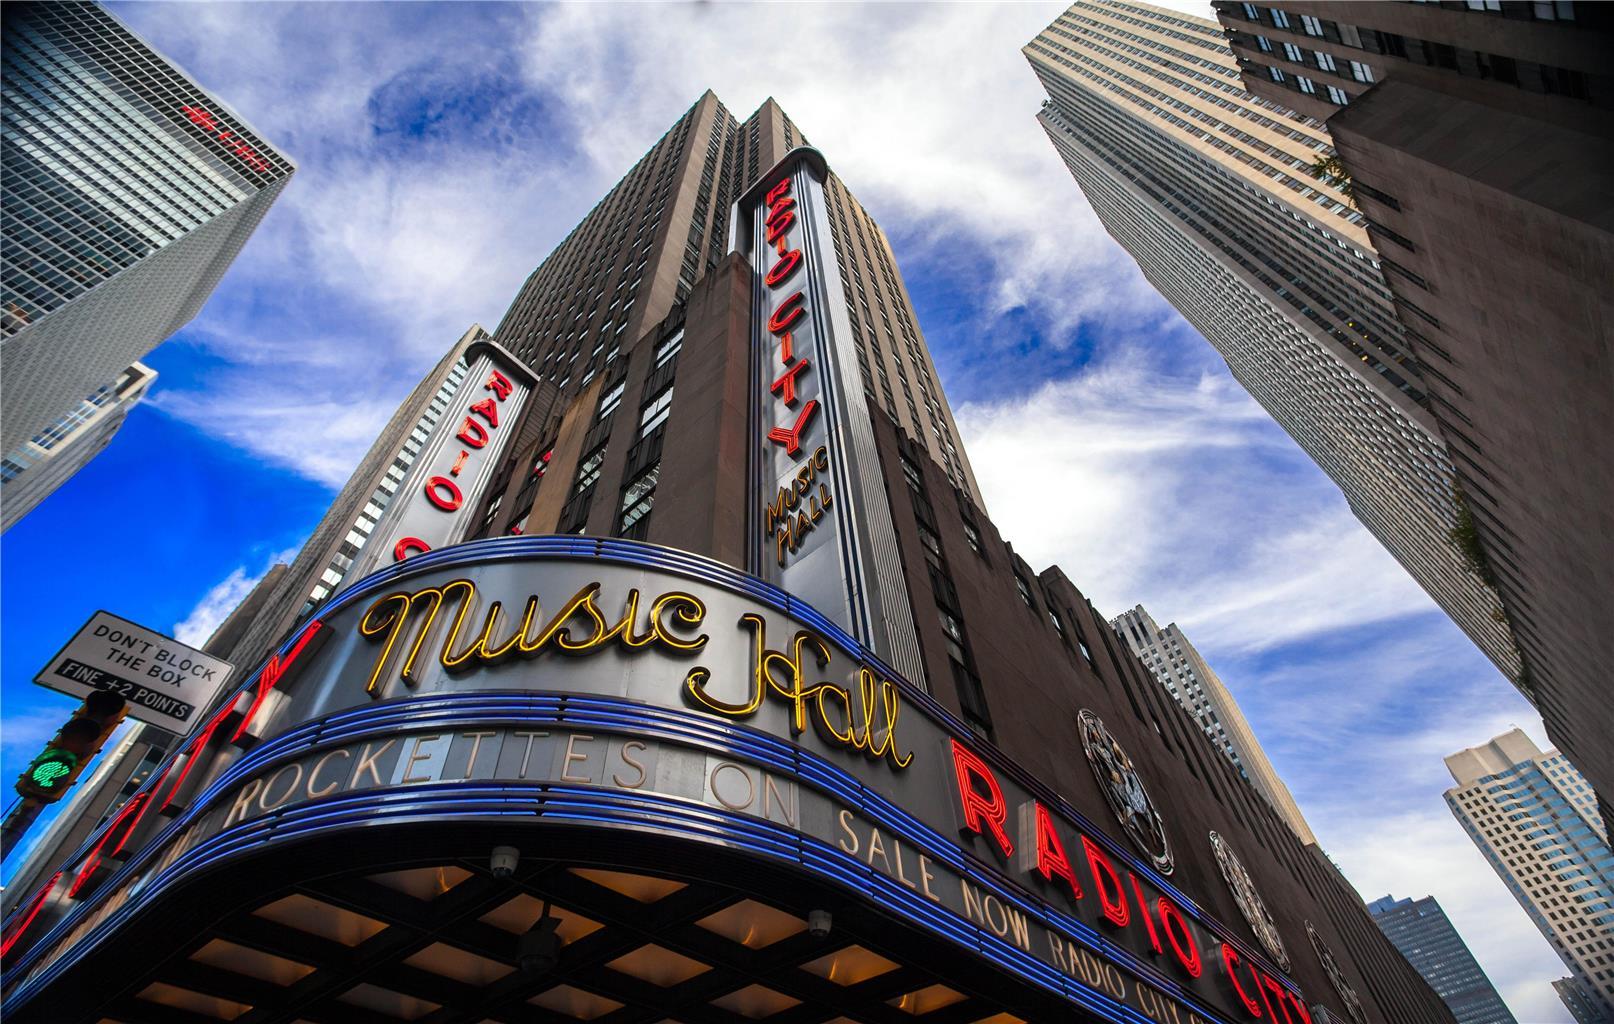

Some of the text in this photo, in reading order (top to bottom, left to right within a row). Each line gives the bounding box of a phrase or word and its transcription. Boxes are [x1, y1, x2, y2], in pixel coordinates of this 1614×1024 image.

[765, 177, 821, 457] RADIO CITY
[425, 369, 514, 512] RADIO
[767, 445, 829, 536] MUSIC
[776, 482, 834, 568] HALL
[62, 662, 189, 718] FINE +2 POINTS
[93, 624, 218, 683] DON'T BLOCK
[105, 647, 187, 689] THE BOX
[360, 577, 915, 770] Music Hall
[222, 730, 1182, 1024] ROCKETTES ON SALE NOW RADIO CITY
[950, 737, 1202, 979] RADIO
